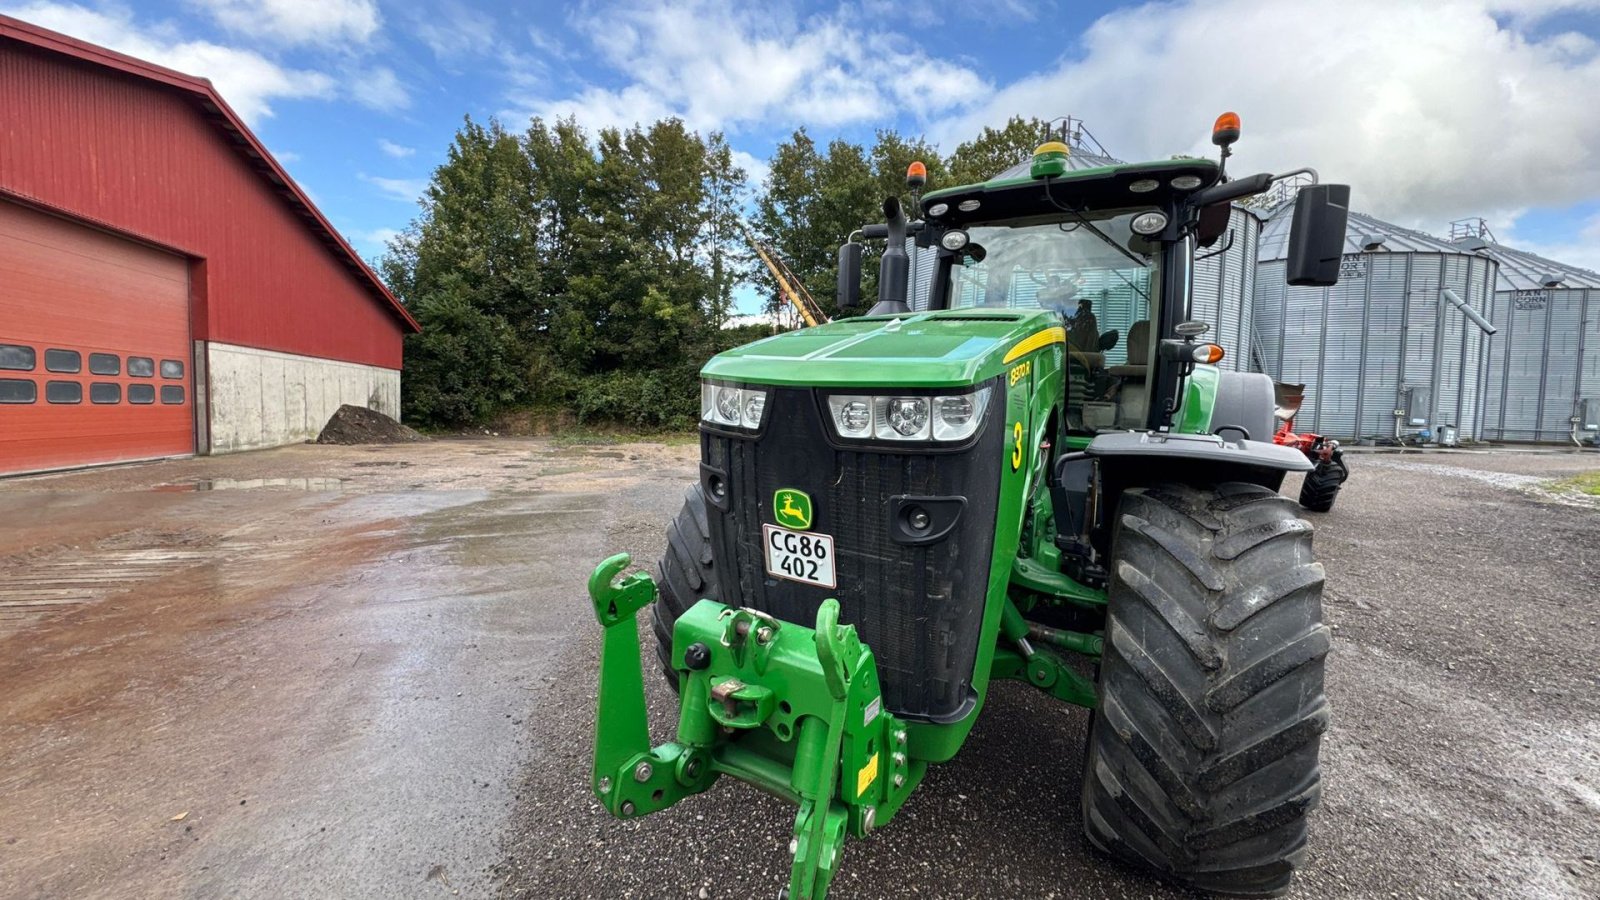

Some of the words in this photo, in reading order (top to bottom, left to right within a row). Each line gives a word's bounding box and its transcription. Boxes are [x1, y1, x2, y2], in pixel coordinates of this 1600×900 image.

[1012, 421, 1022, 470] 3
[770, 530, 827, 560] CG86
[780, 555, 819, 581] 402
